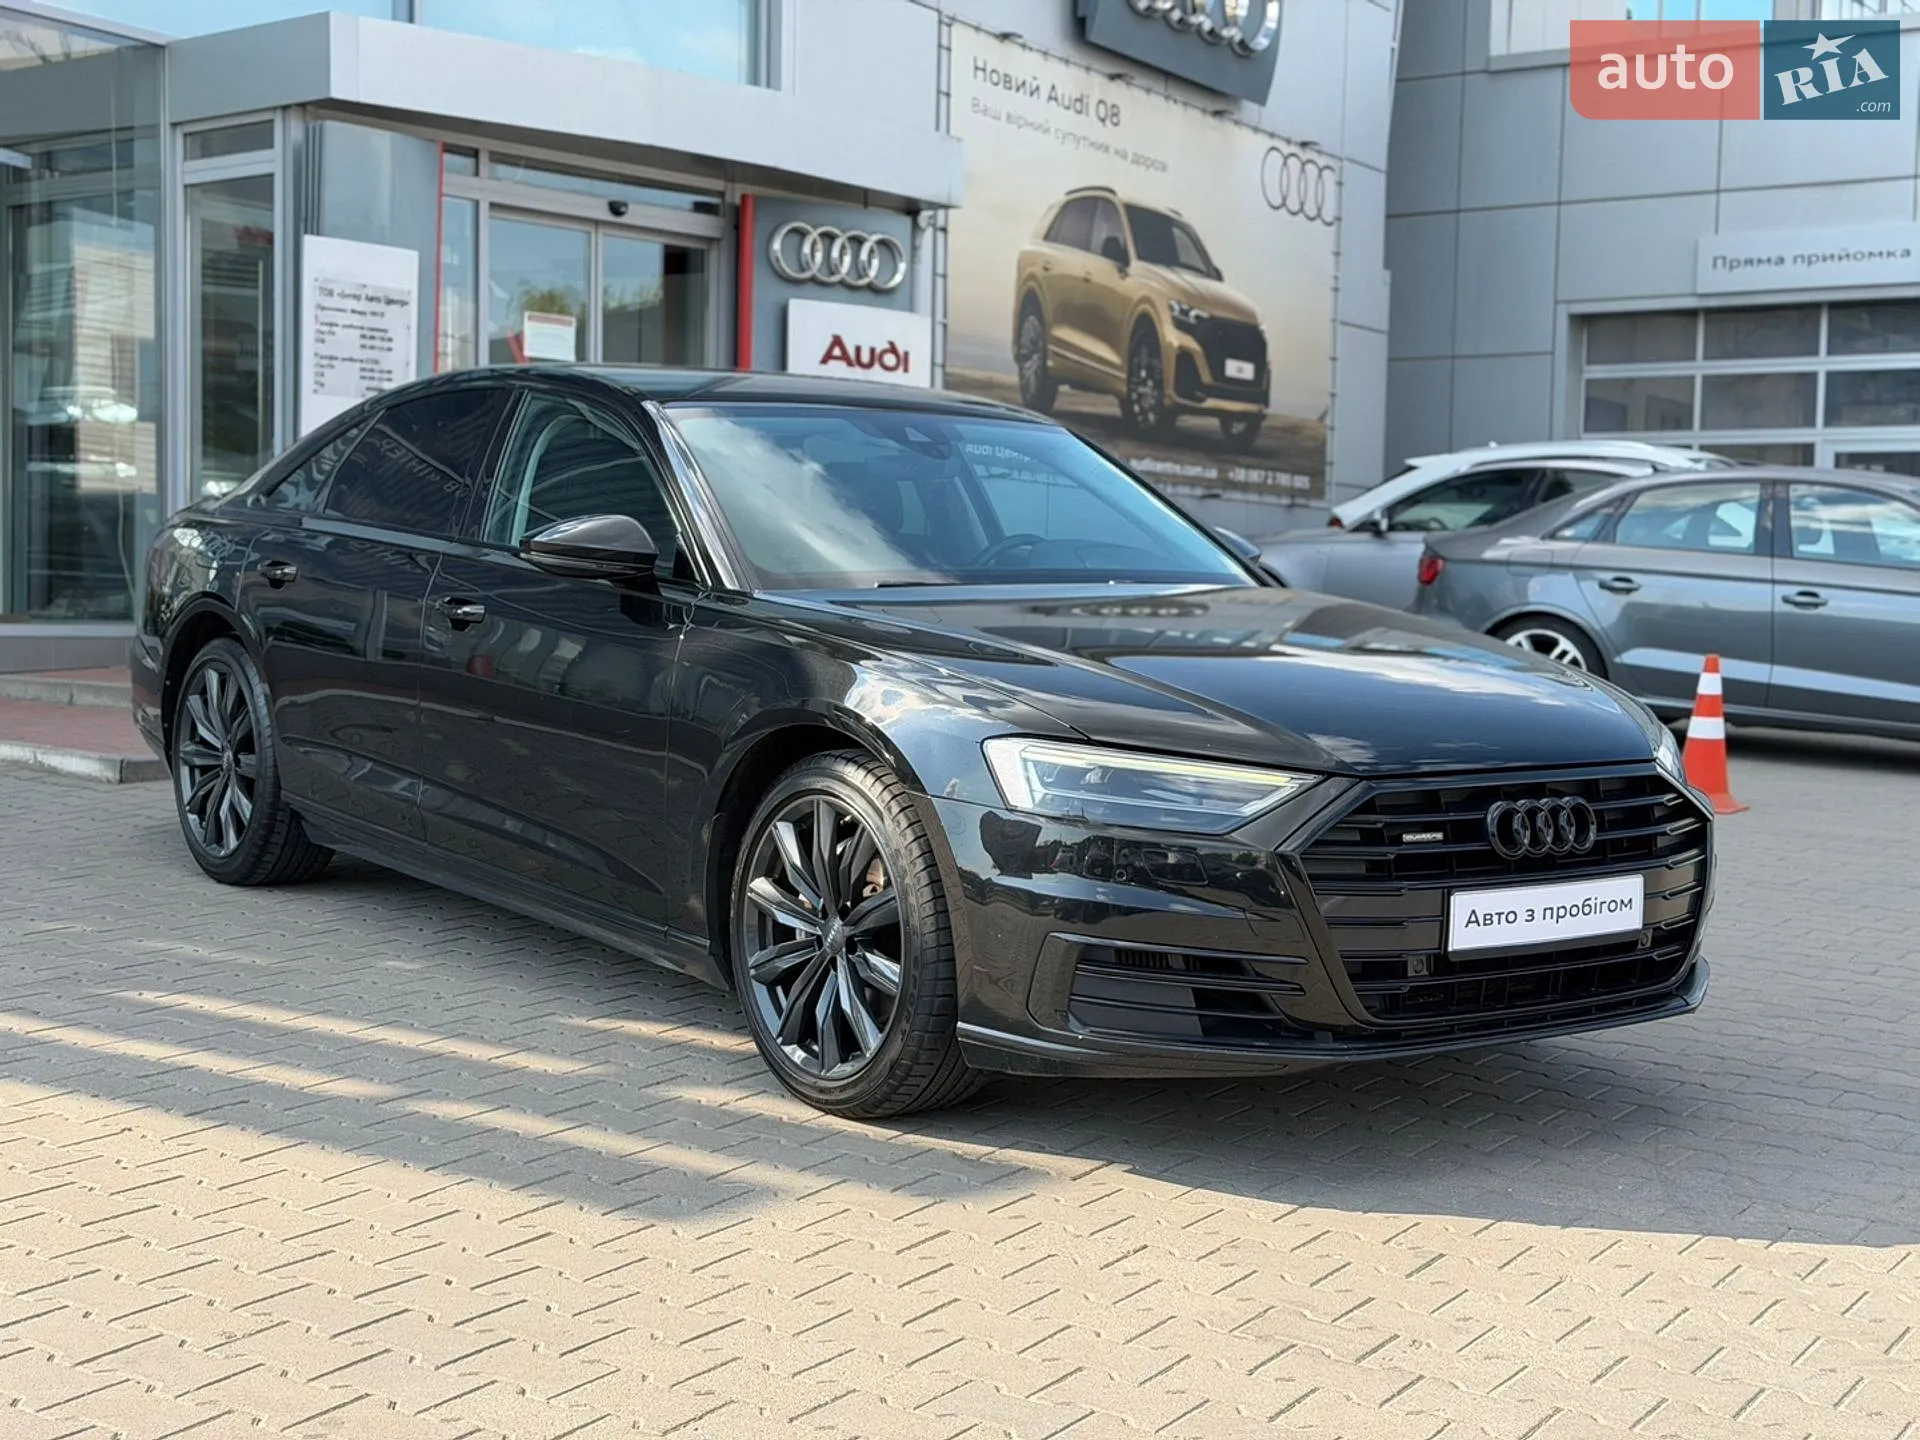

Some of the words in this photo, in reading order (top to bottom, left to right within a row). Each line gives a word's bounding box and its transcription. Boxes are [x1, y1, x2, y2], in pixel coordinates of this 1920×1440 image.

[972, 55, 1041, 100] Новий
[1046, 83, 1090, 117] Audi
[1095, 98, 1121, 128] Q8
[970, 96, 1002, 121] Ваш
[1006, 111, 1051, 136] вірний
[1712, 255, 1785, 272] Пряма
[1792, 247, 1912, 268] прийомка
[819, 333, 910, 374] Audi
[1464, 909, 1518, 929] Авто
[1523, 907, 1535, 923] з
[1541, 896, 1633, 925] пробігом
